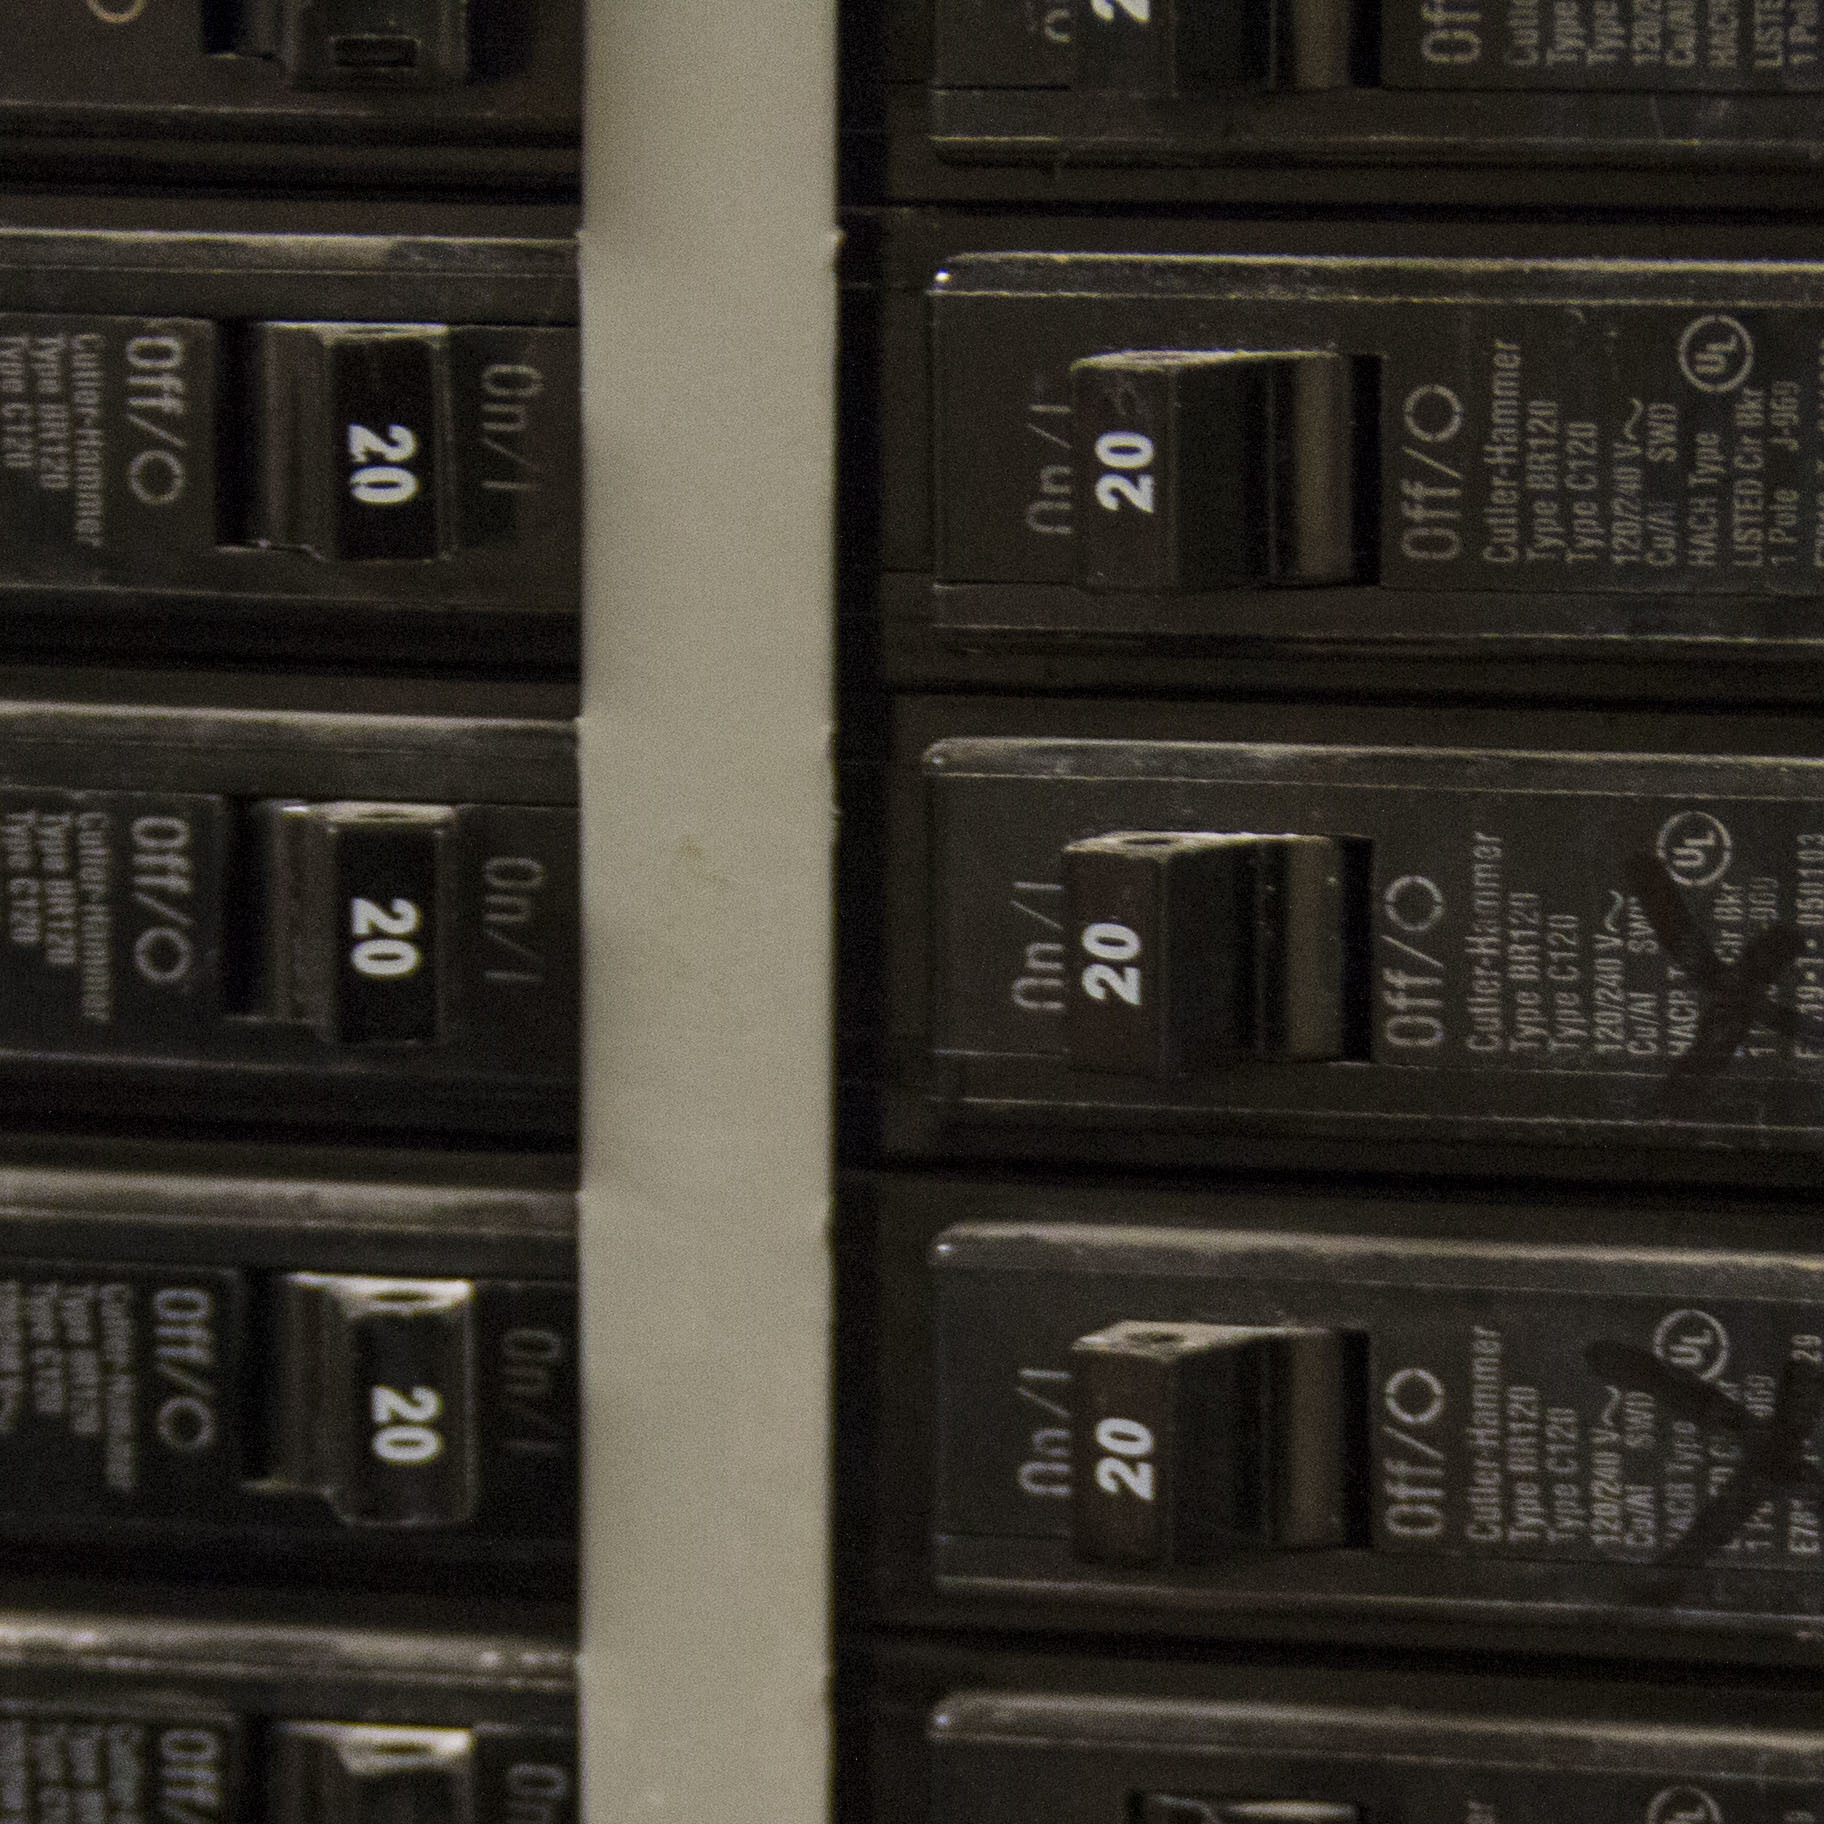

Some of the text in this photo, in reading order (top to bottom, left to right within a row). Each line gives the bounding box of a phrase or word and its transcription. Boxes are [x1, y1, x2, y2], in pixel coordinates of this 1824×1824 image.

[30, 335, 65, 393] Type
[345, 422, 418, 507] 20
[1095, 429, 1155, 514] 20
[1483, 336, 1522, 564] Cutler-Hammer
[1647, 401, 1678, 463] SWD
[1688, 430, 1725, 486] Type
[1526, 398, 1566, 563] Type BR120
[1565, 419, 1606, 564] Type C120
[1611, 466, 1643, 565] 120/240
[1733, 478, 1764, 567] LISTED
[1770, 486, 1799, 543] Pole
[349, 895, 422, 980] 20
[1080, 919, 1141, 1006] 20
[1466, 830, 1503, 1052] Cutler-Hammer
[1509, 989, 1547, 1052] Type
[1548, 912, 1588, 1052] Type C120
[1594, 957, 1625, 1054] 120/240
[369, 1384, 442, 1464] 20
[1095, 1415, 1155, 1500] 20
[1508, 1480, 1546, 1542] Type
[1546, 1481, 1585, 1544] Type
